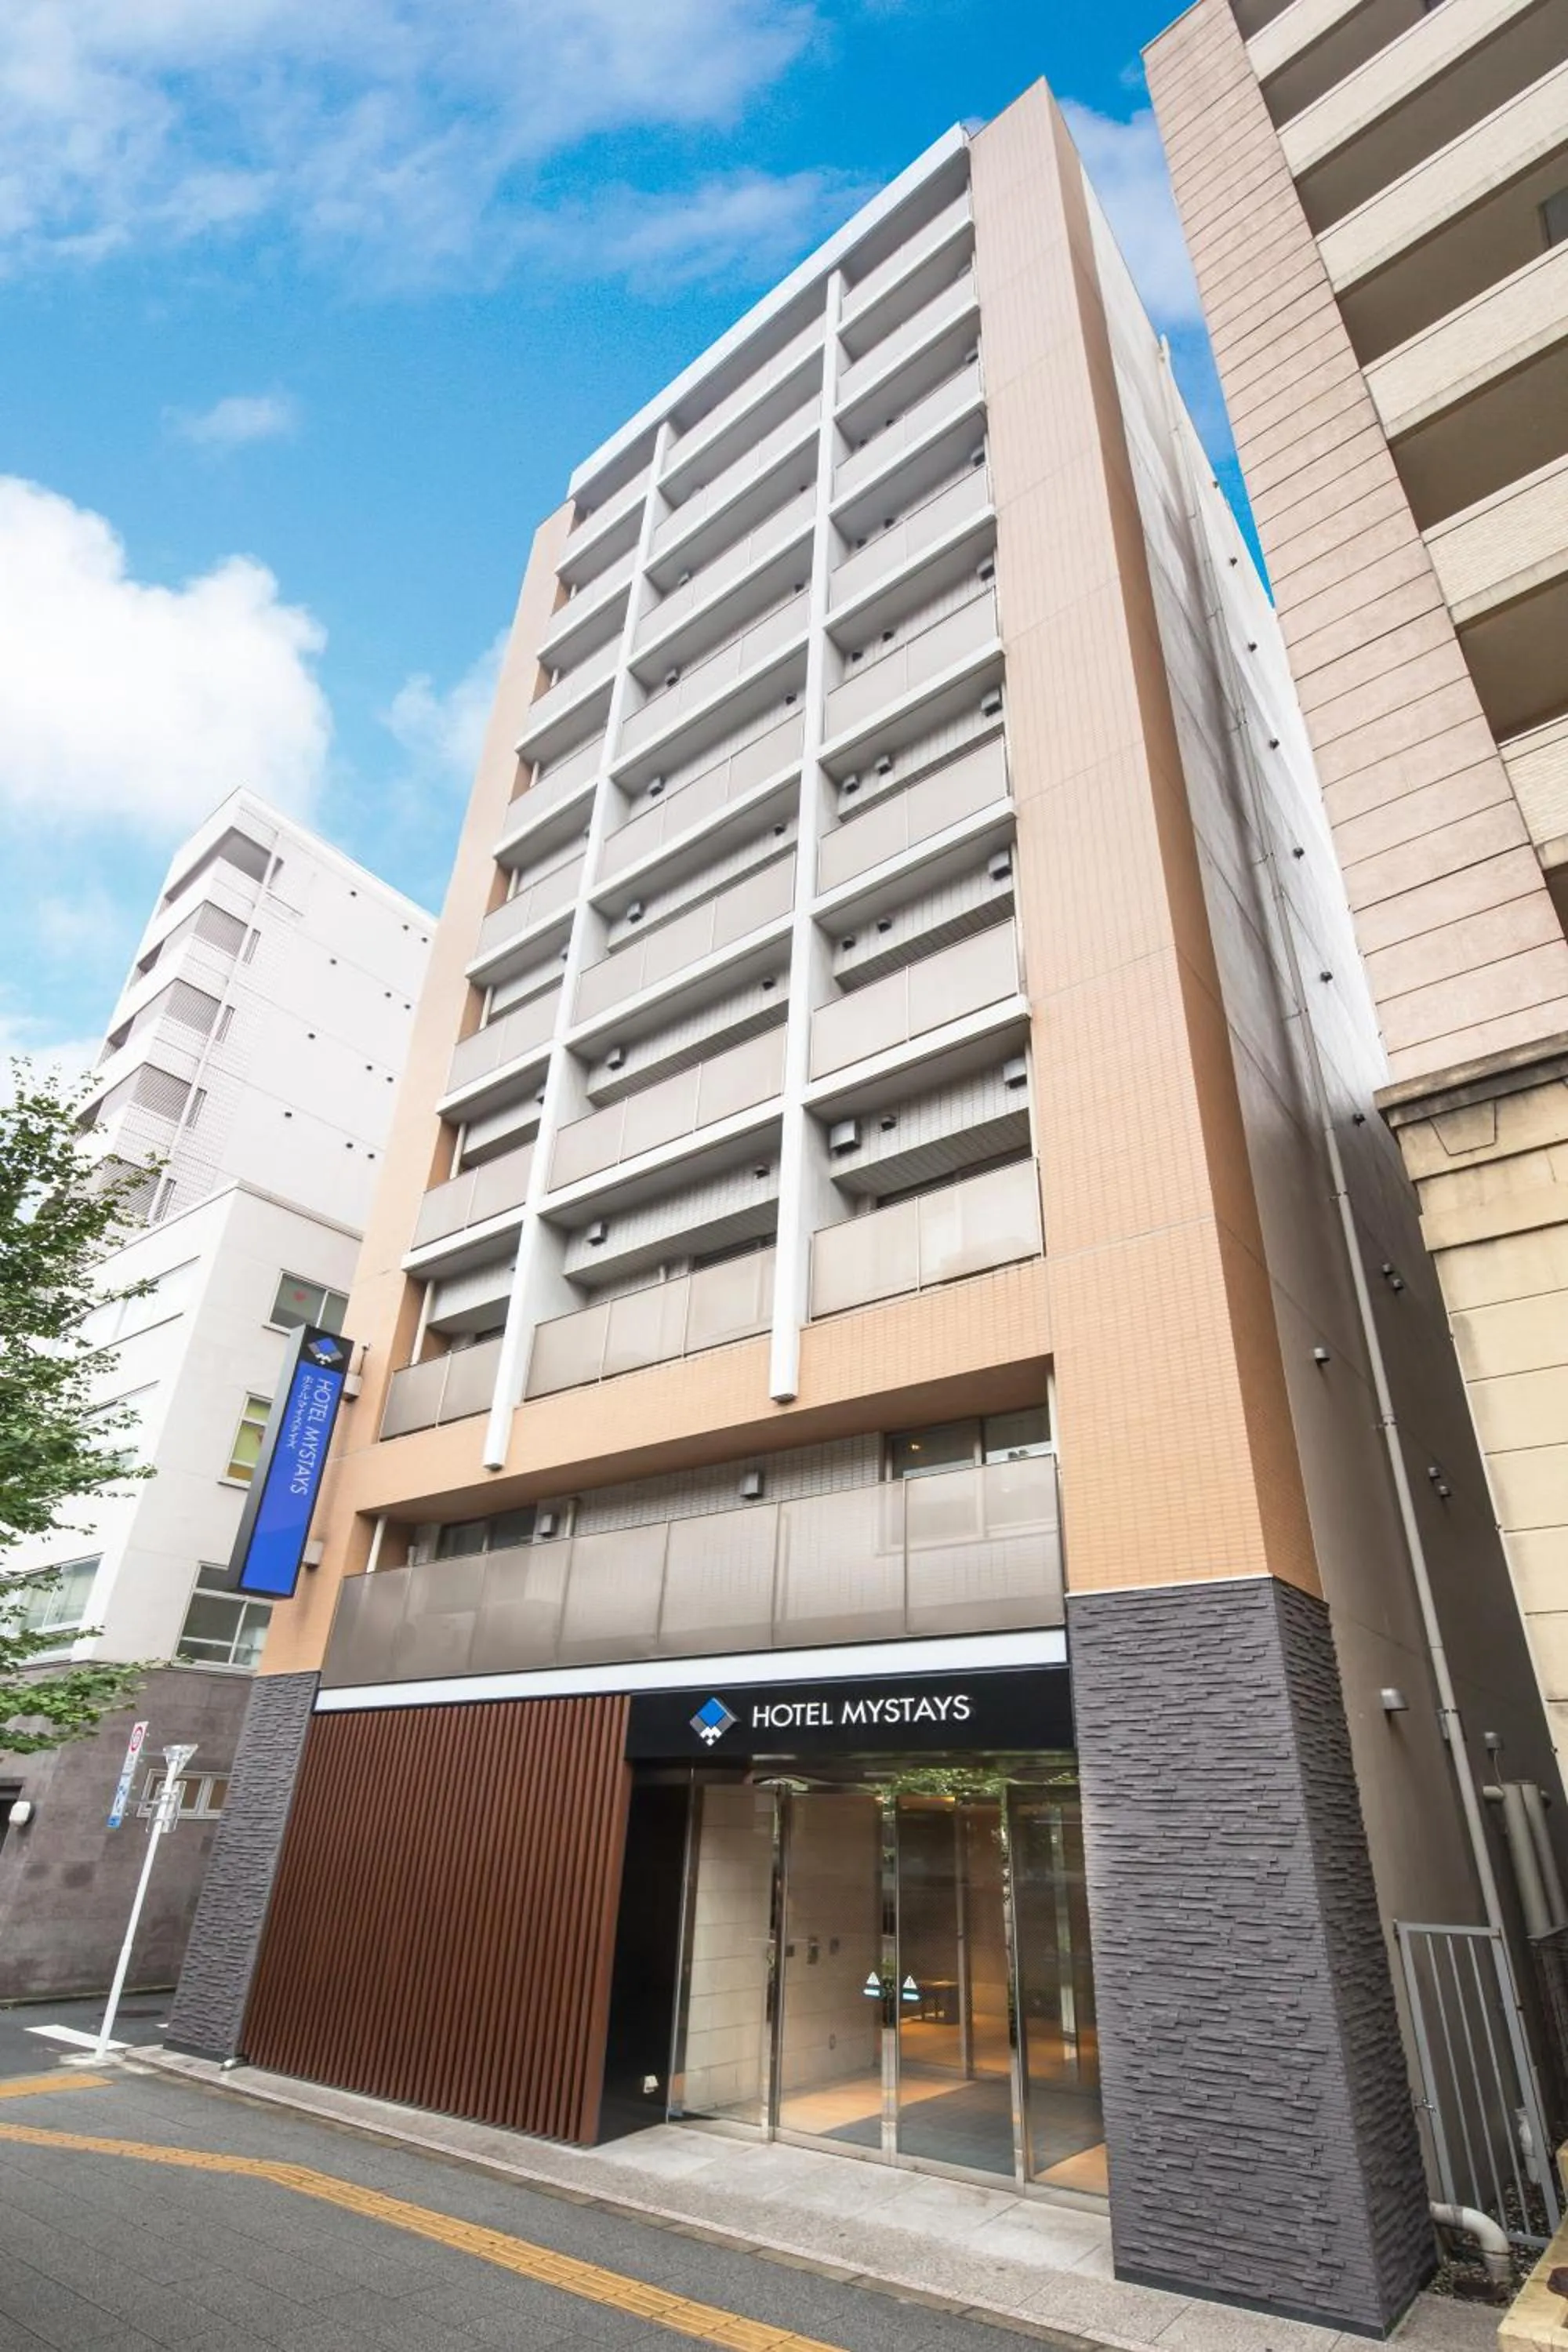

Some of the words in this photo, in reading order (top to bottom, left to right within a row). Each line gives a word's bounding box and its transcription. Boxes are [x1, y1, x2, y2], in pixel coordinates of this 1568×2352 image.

[308, 1377, 334, 1422] HOTEL
[291, 1426, 321, 1496] MYSTAYS
[753, 1703, 833, 1728] HOTEL
[841, 1695, 971, 1724] MYSTAYS
